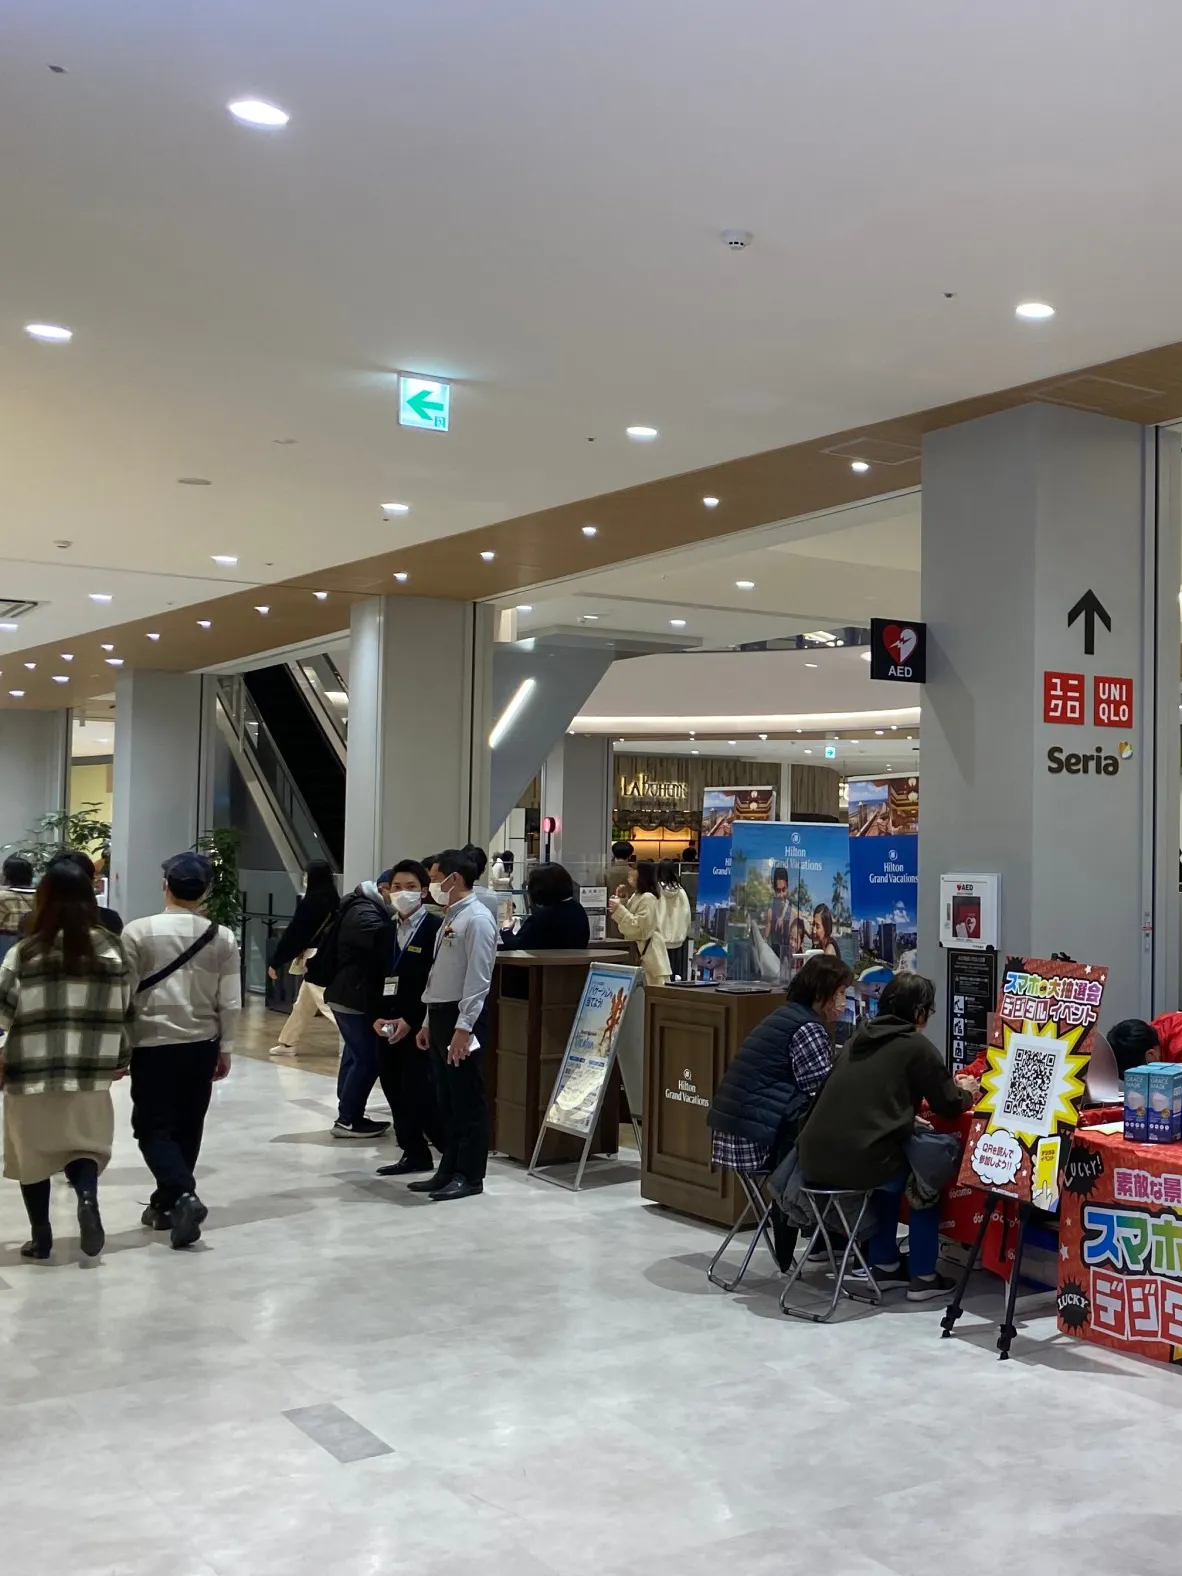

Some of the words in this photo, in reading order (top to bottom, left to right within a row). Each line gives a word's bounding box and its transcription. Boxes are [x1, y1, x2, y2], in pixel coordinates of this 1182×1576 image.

[888, 665, 912, 678] AED
[1099, 682, 1126, 702] UNI
[1099, 703, 1129, 723] QLO
[1047, 745, 1120, 776] Seria
[784, 846, 806, 858] Hilton
[883, 862, 904, 872] Hilton
[869, 873, 888, 884] Grand
[678, 1080, 697, 1092] Hilton
[665, 1089, 682, 1101] Grand
[682, 1092, 709, 1107] Vacations
[1058, 1294, 1089, 1311] LUCKY
